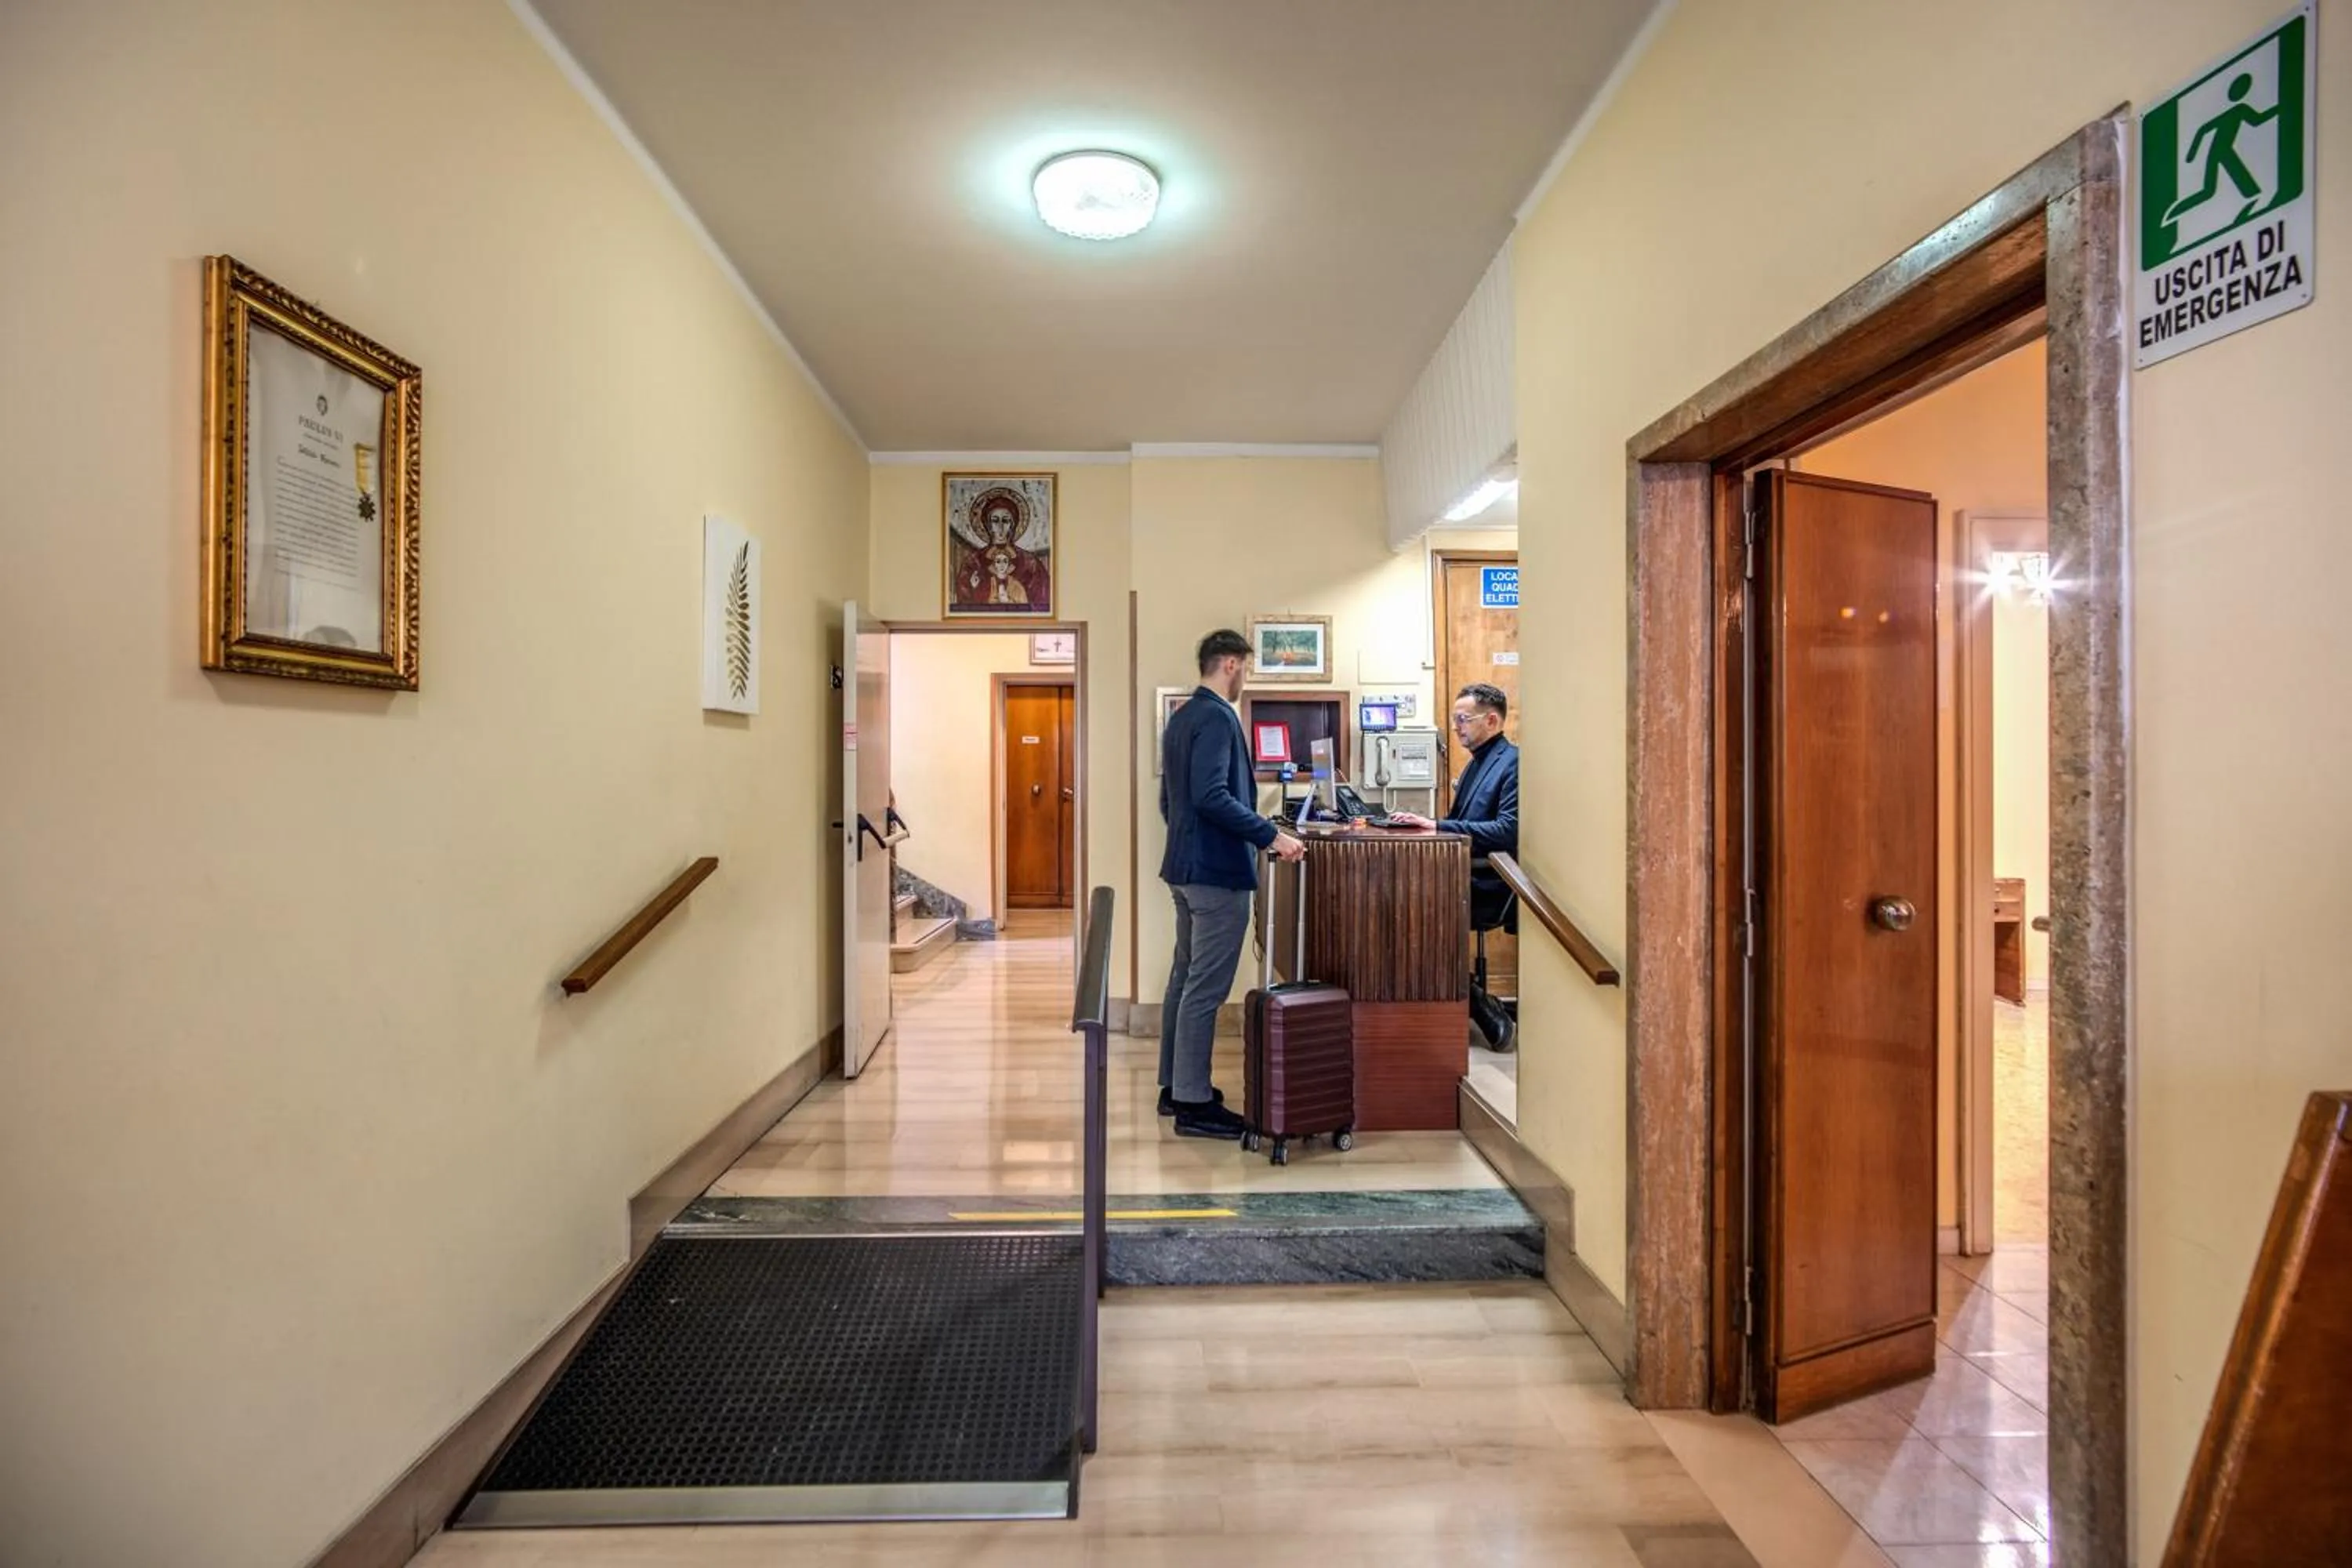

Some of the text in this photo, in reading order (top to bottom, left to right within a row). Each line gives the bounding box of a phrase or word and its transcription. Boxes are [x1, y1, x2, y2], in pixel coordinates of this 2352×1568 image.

[2140, 255, 2303, 348] EMERGENZA
[2155, 220, 2284, 305] USCITA DI
